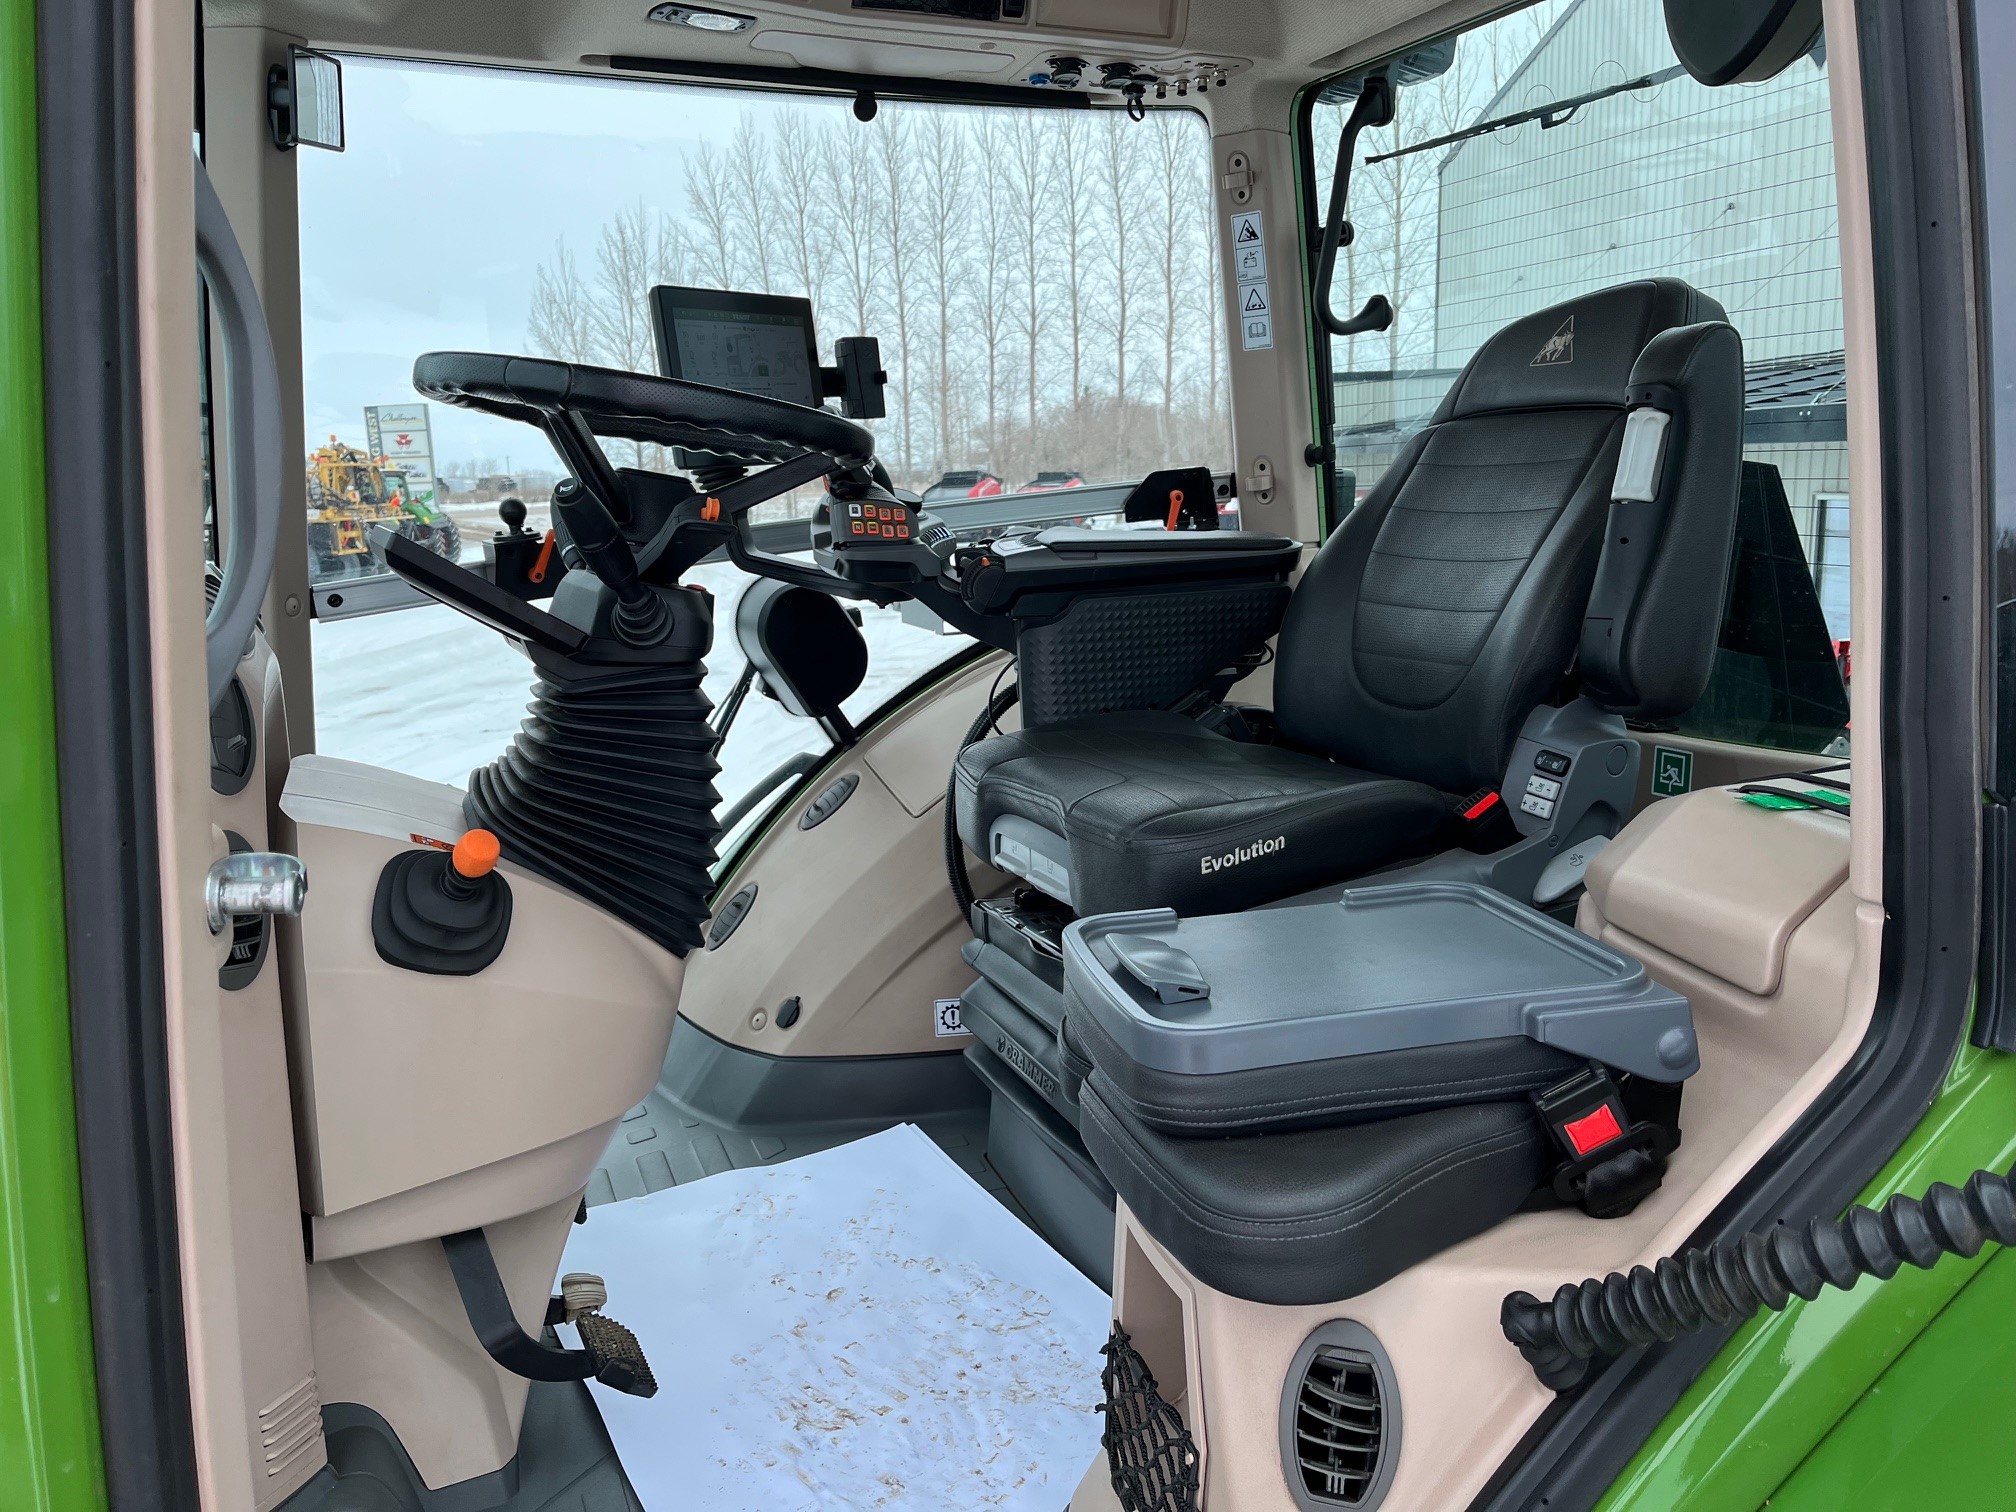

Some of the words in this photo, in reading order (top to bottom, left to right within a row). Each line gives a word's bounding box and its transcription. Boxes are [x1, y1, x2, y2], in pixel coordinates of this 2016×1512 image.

[366, 411, 380, 445] WEST
[1200, 835, 1286, 875] Evolution
[1006, 1043, 1057, 1101] GRAMMER
